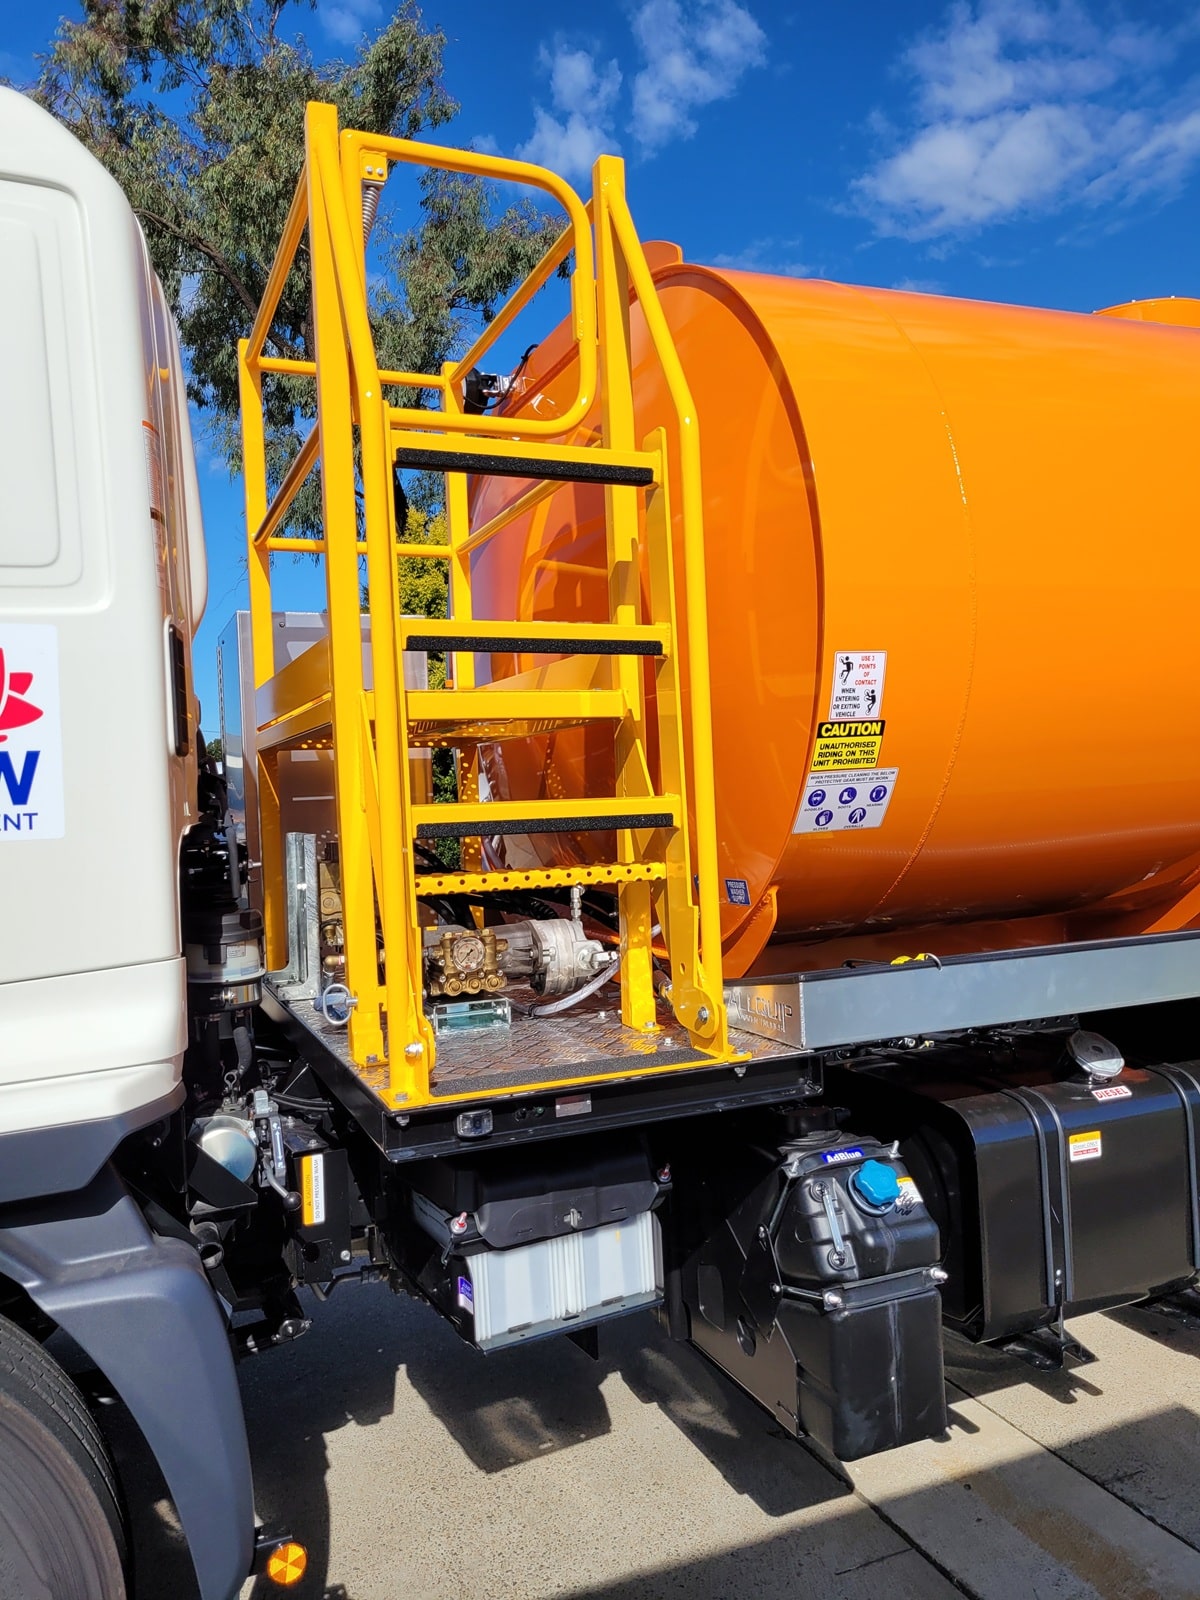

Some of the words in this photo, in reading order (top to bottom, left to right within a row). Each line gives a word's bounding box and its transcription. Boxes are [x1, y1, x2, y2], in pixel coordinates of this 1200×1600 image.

[821, 722, 882, 737] CAUTION
[819, 741, 877, 750] UNAUTHORISED
[813, 759, 831, 767] UNIT
[832, 757, 876, 766] PROHIBITED
[0, 813, 38, 831] NT
[1095, 1087, 1129, 1099] DIESEL
[826, 1151, 863, 1163] AdBlue
